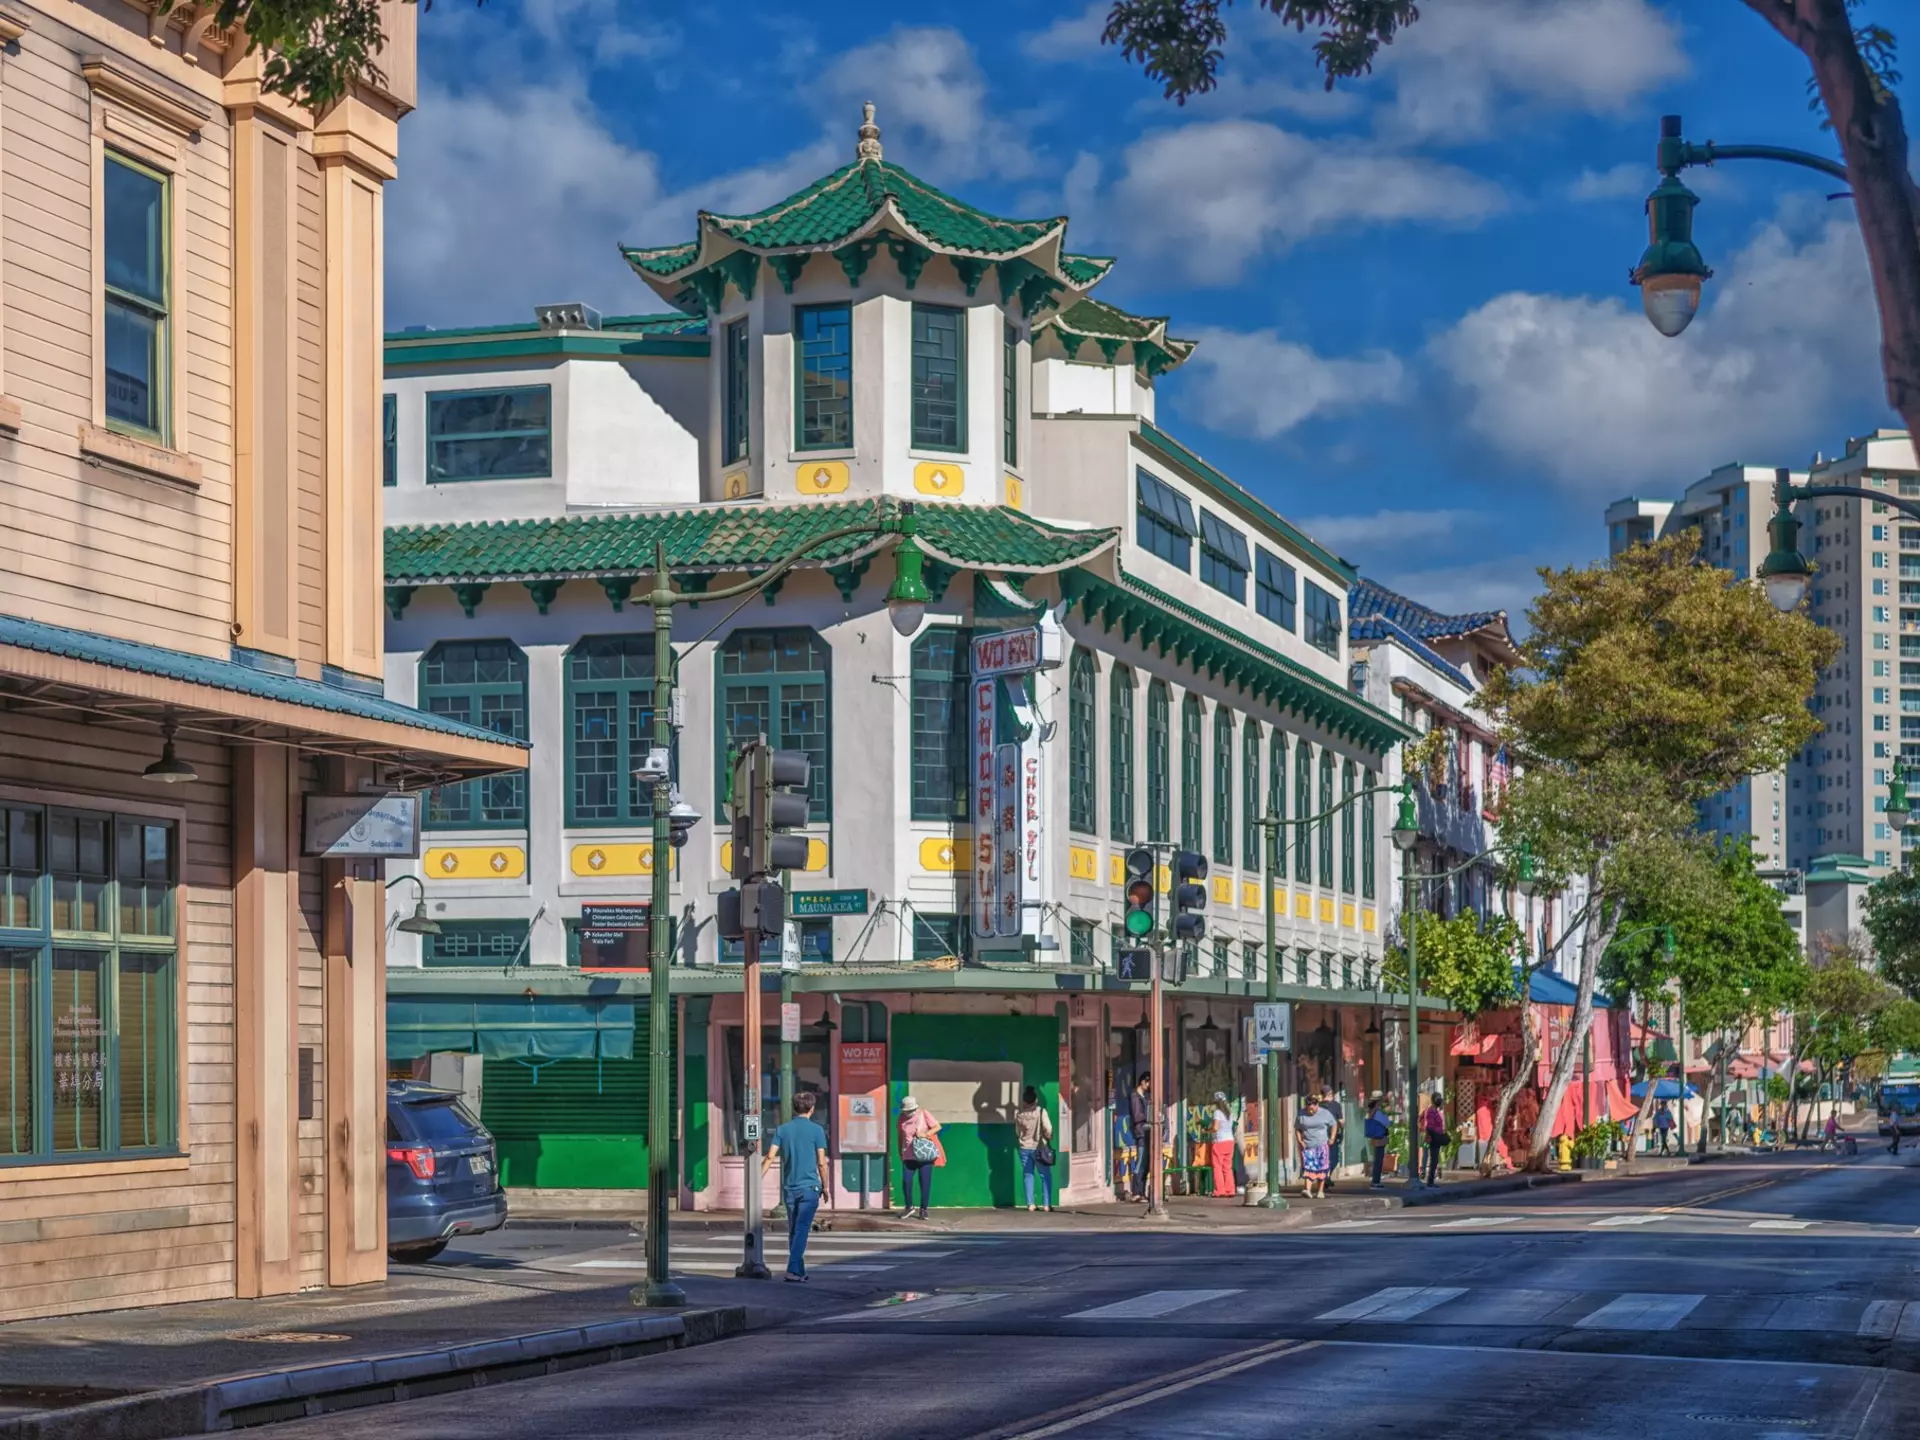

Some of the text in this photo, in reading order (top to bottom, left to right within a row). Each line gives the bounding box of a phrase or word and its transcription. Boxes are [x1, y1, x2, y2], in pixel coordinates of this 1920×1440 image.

[978, 632, 1036, 669] WO FAT
[979, 684, 992, 817] CHOP
[1026, 757, 1038, 823] CHOP
[368, 810, 406, 825] Department
[799, 902, 853, 913] MAUNAKEA
[788, 929, 798, 944] NO
[784, 949, 800, 963] TURNS
[1258, 1020, 1285, 1031] WAY
[843, 1047, 881, 1058] WO FAT
